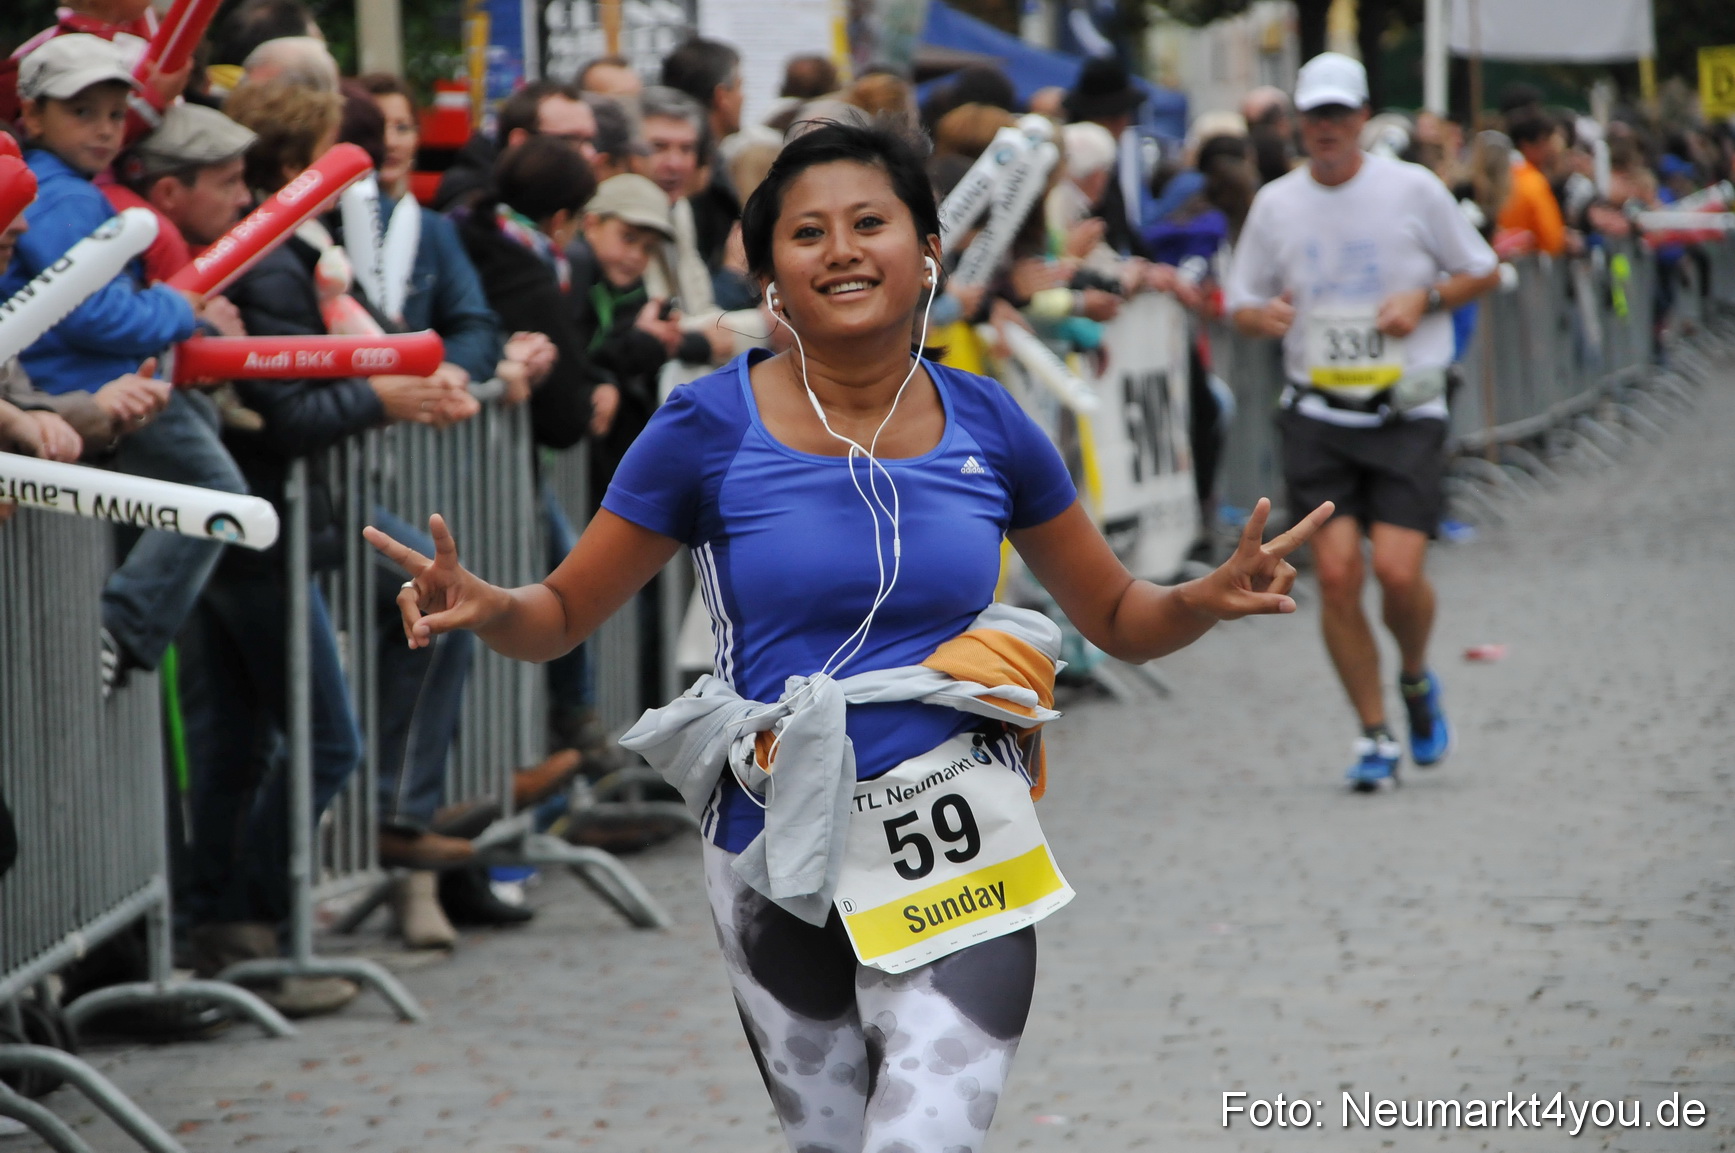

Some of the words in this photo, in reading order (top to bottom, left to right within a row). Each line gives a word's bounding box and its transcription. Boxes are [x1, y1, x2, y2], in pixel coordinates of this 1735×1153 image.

[193, 235, 238, 274] Audi
[233, 208, 273, 240] BKK
[243, 351, 291, 370] Audi
[294, 351, 336, 369] BKK
[1325, 327, 1384, 361] 330
[93, 494, 182, 533] BMW
[850, 792, 882, 815] TL
[885, 757, 975, 806] Neumarkt
[883, 794, 981, 881] 59
[903, 881, 1006, 933] Sunday
